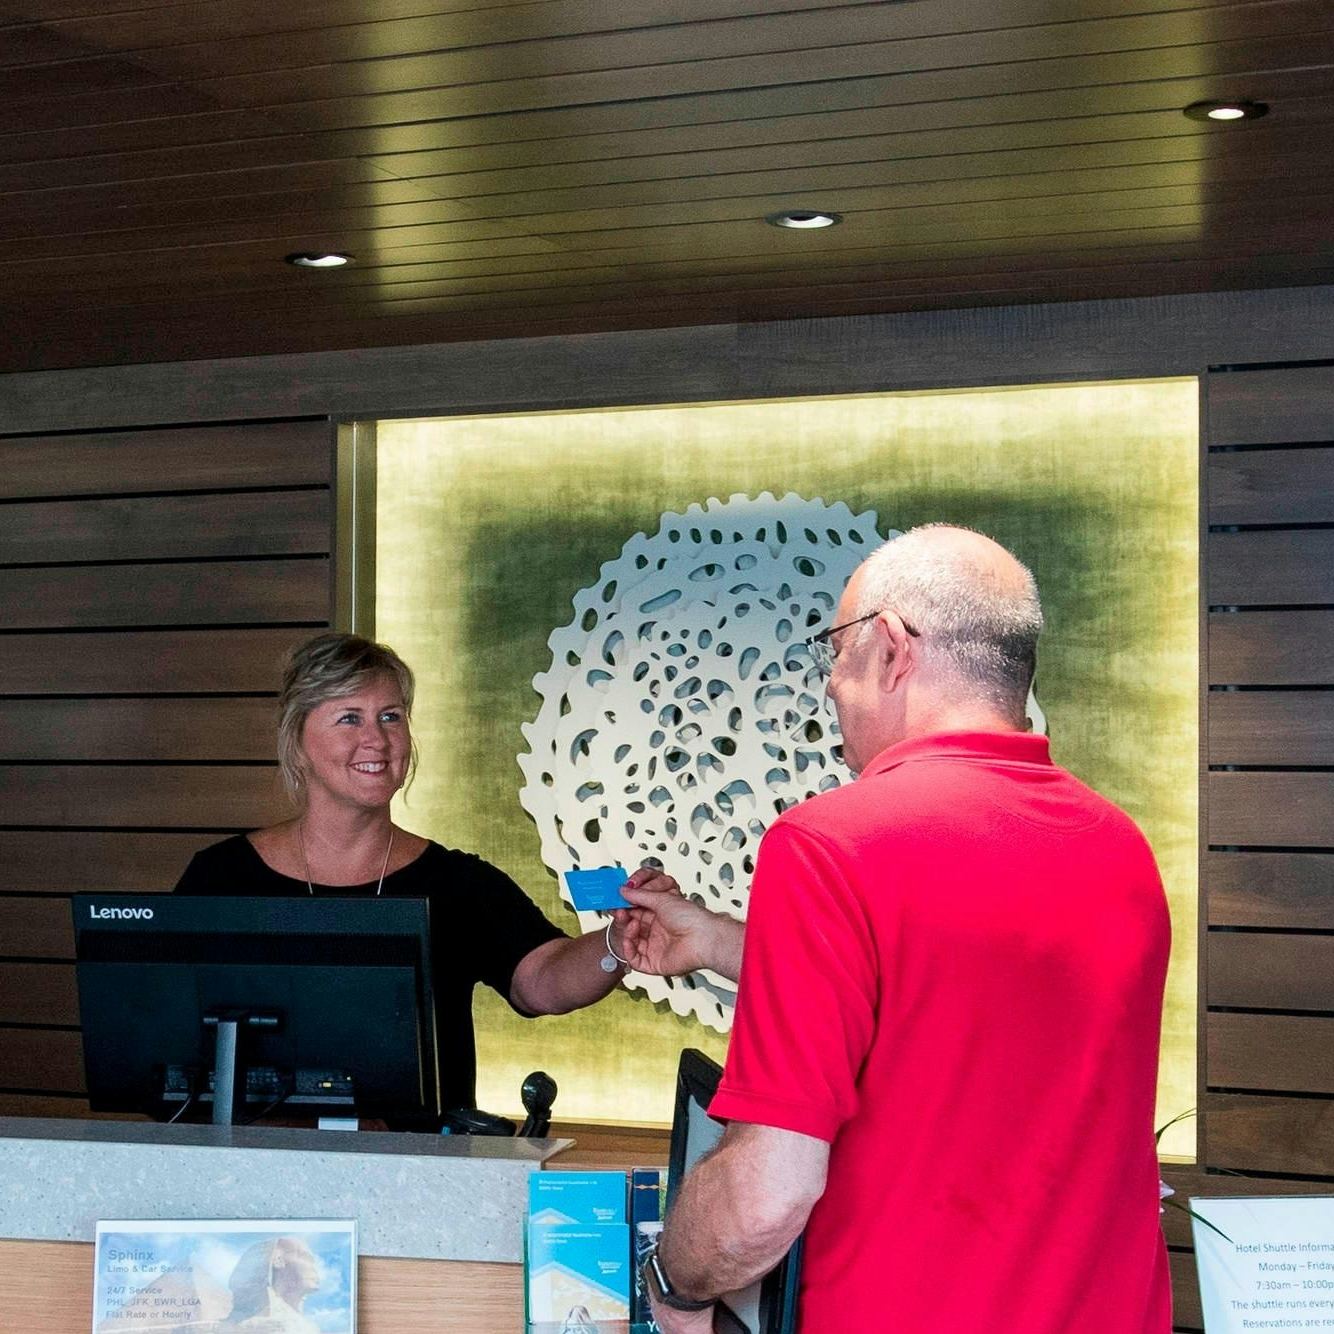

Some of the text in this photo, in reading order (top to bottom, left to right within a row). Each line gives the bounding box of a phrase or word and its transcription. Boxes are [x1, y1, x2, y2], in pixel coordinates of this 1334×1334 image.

[90, 904, 154, 920] Lenovo
[1235, 1243, 1261, 1254] Hotel
[1263, 1243, 1297, 1253] Shuttle
[107, 1248, 154, 1263] Sphinx
[107, 1264, 194, 1273] Limo & Car Service
[1258, 1262, 1298, 1272] Monday
[106, 1286, 163, 1295] 24/7 Service
[1256, 1281, 1291, 1290] 7:30am
[1231, 1300, 1249, 1310] The
[1251, 1299, 1284, 1309] shuttle
[1286, 1301, 1307, 1309] runs
[1308, 1300, 1334, 1310] every
[106, 1310, 123, 1319] Flat
[125, 1310, 147, 1319] Rate
[162, 1310, 192, 1320] Hourly
[1242, 1318, 1303, 1329] Reservations
[1304, 1319, 1320, 1327] are
